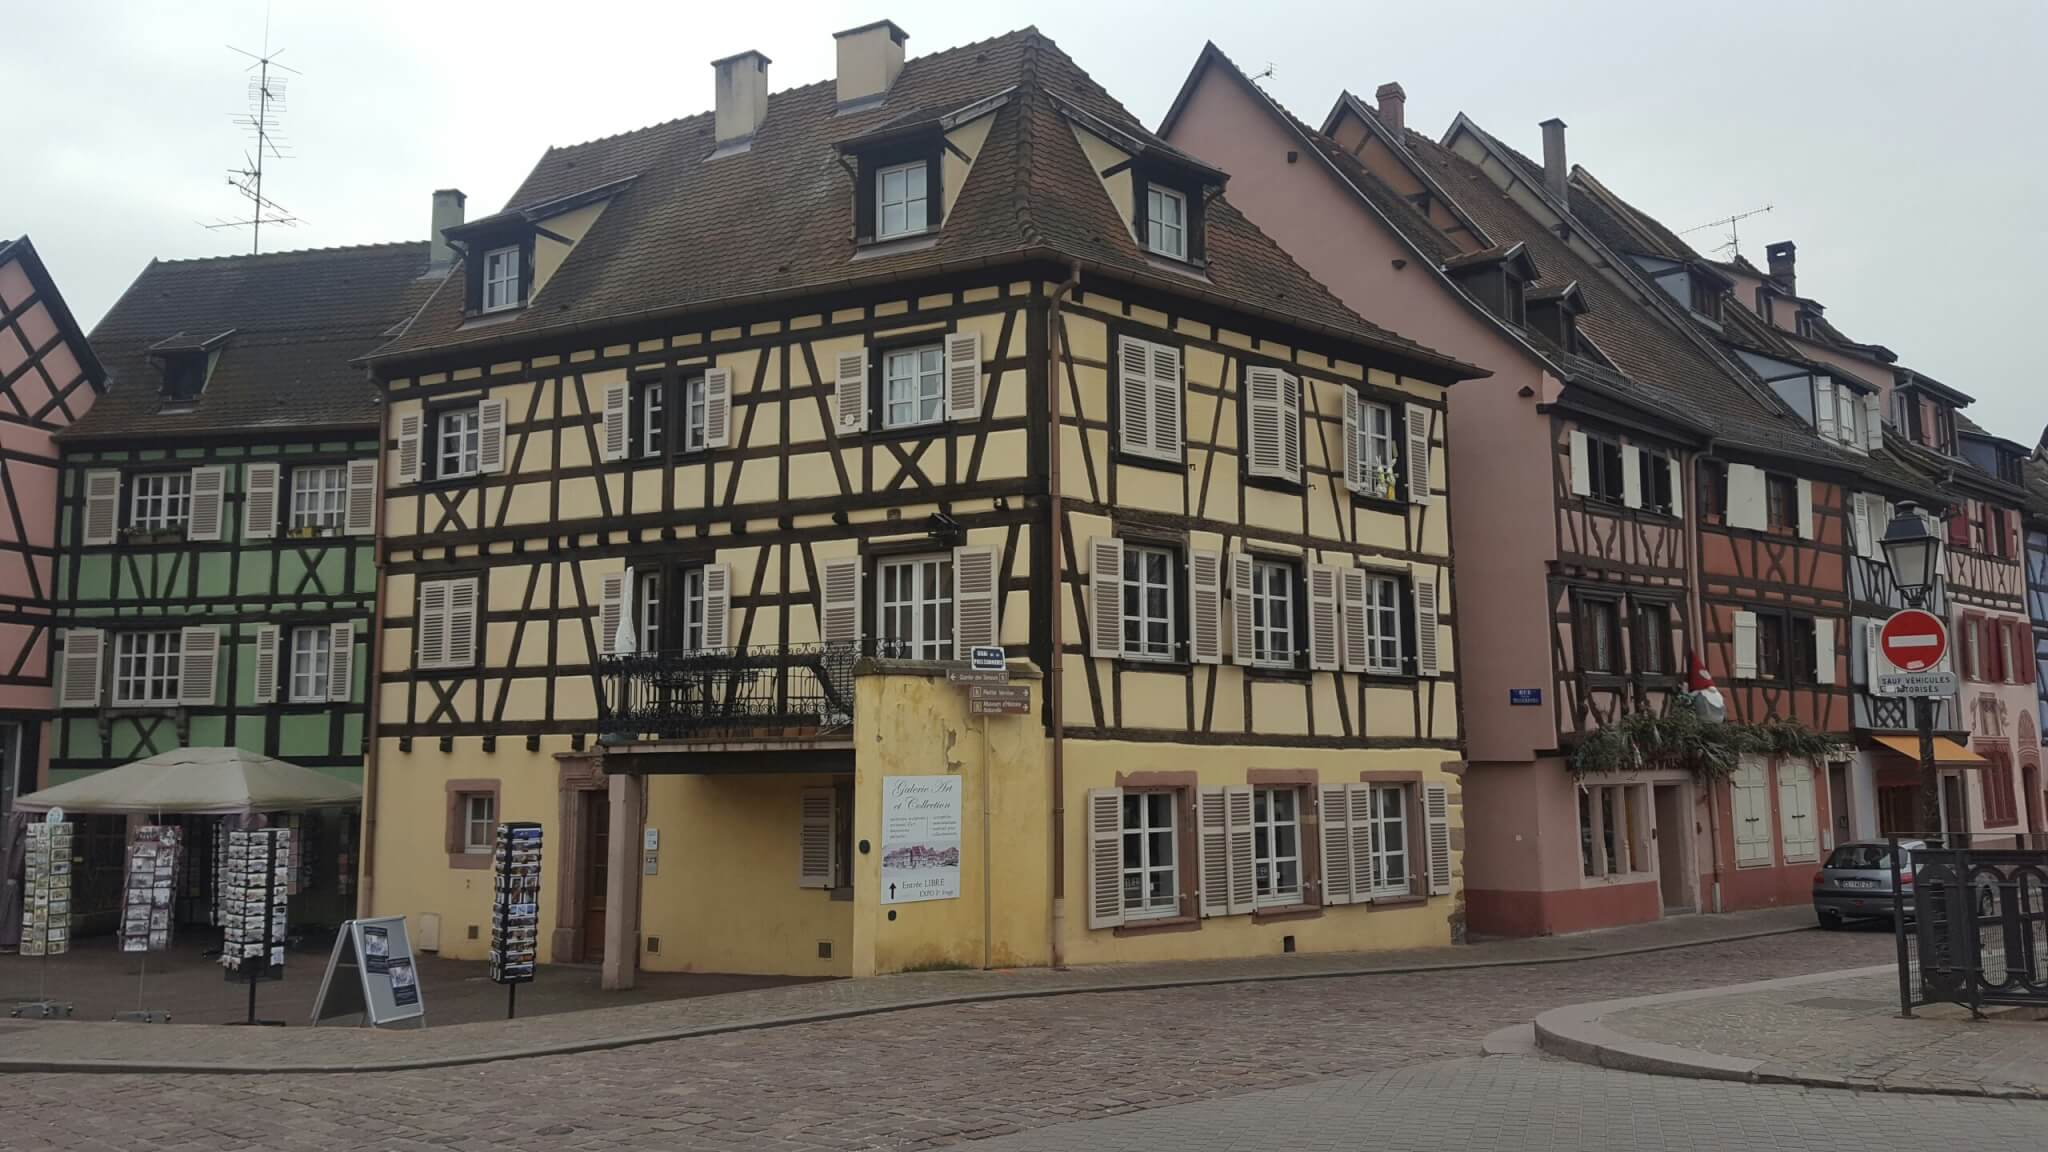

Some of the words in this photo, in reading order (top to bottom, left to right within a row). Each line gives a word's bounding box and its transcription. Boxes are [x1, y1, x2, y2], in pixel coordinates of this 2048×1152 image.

[892, 779, 928, 797] Galerie
[930, 780, 953, 793] Art
[904, 796, 951, 810] Collection
[924, 878, 945, 888] LIBRE
